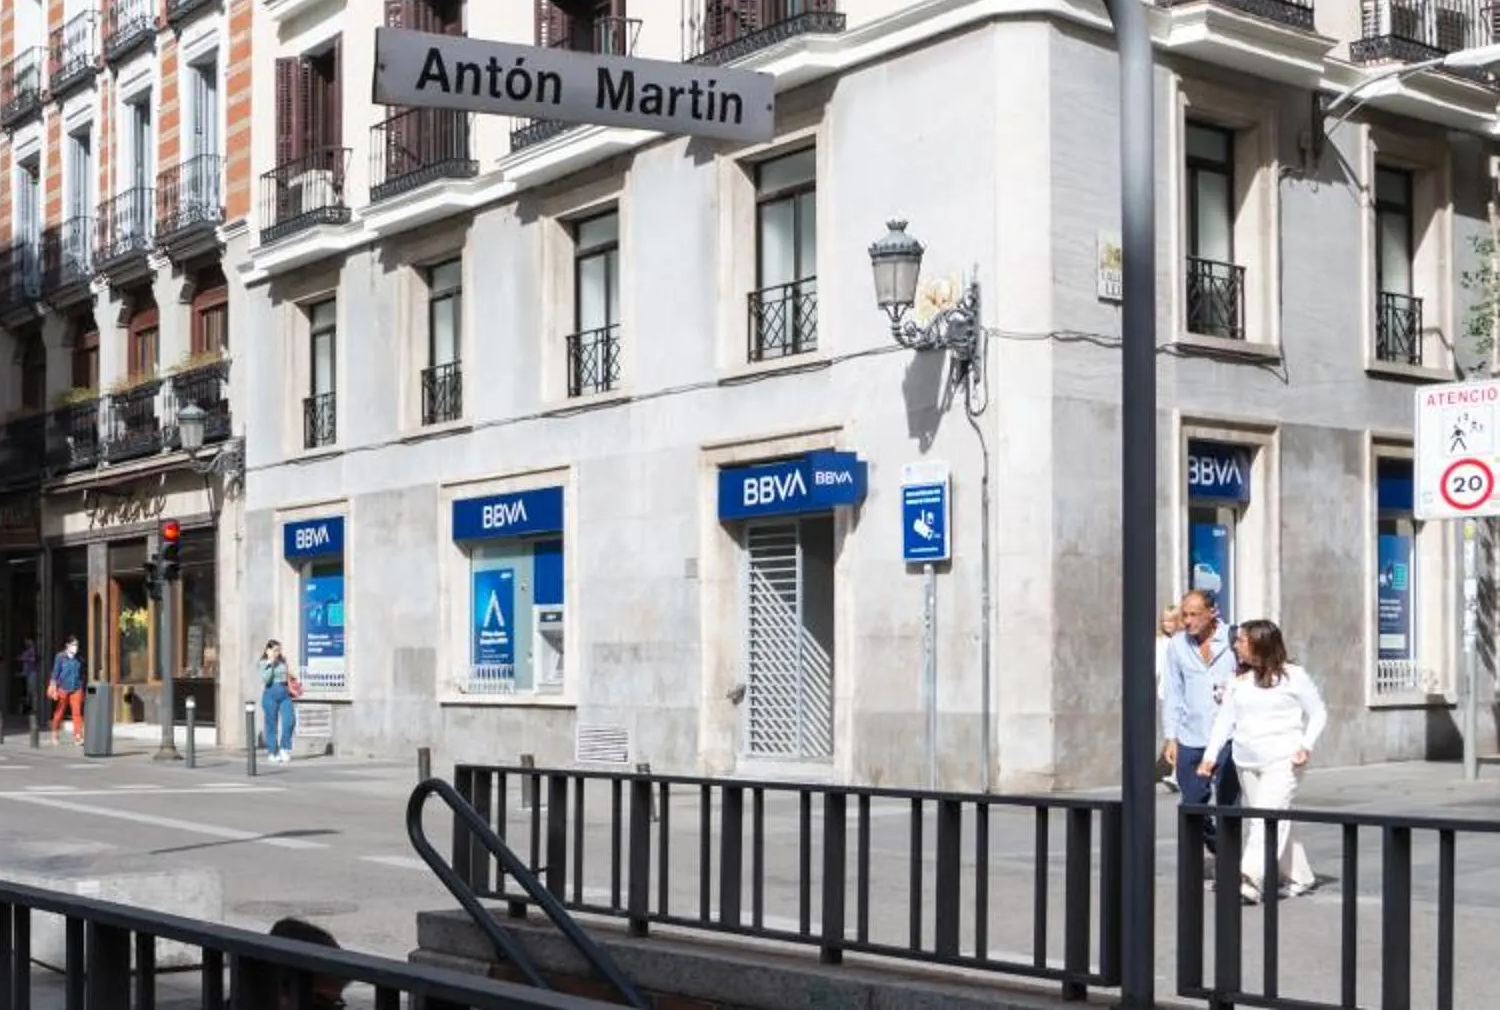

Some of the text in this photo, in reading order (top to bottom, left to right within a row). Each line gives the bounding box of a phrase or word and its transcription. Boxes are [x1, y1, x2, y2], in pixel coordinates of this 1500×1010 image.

[415, 46, 744, 125] Antón Martín
[815, 470, 853, 484] BBVA
[1188, 456, 1243, 485] BBVA
[1453, 475, 1483, 492] 20
[743, 469, 807, 506] BBVA
[483, 499, 527, 528] BBVA
[295, 524, 330, 549] BBVA
